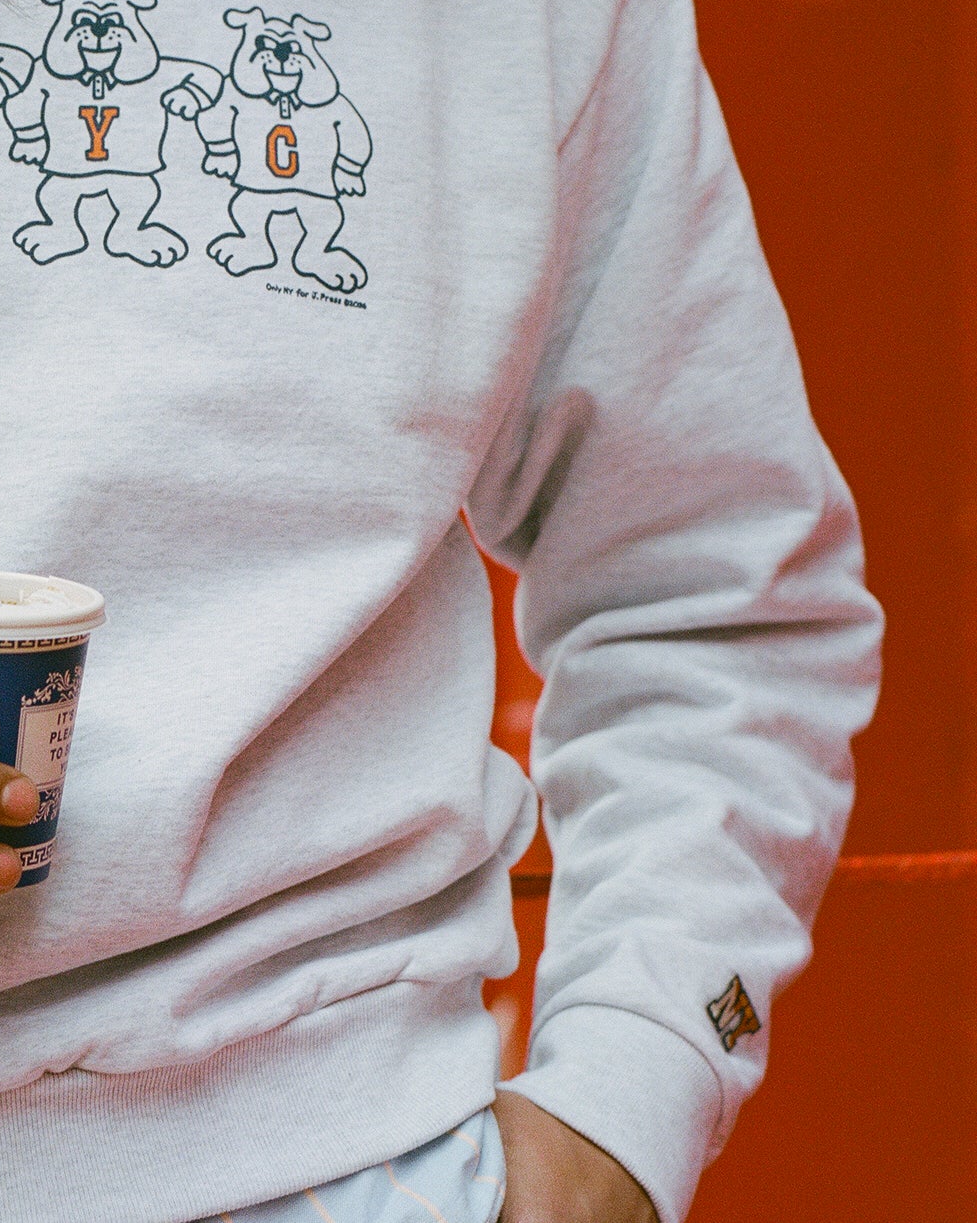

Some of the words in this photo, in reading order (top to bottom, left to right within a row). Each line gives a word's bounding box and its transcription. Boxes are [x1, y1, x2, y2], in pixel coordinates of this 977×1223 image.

[78, 105, 120, 161] Y
[265, 124, 299, 178] C
[266, 283, 281, 294] Only
[296, 288, 309, 297] for
[50, 747, 63, 761] TO
